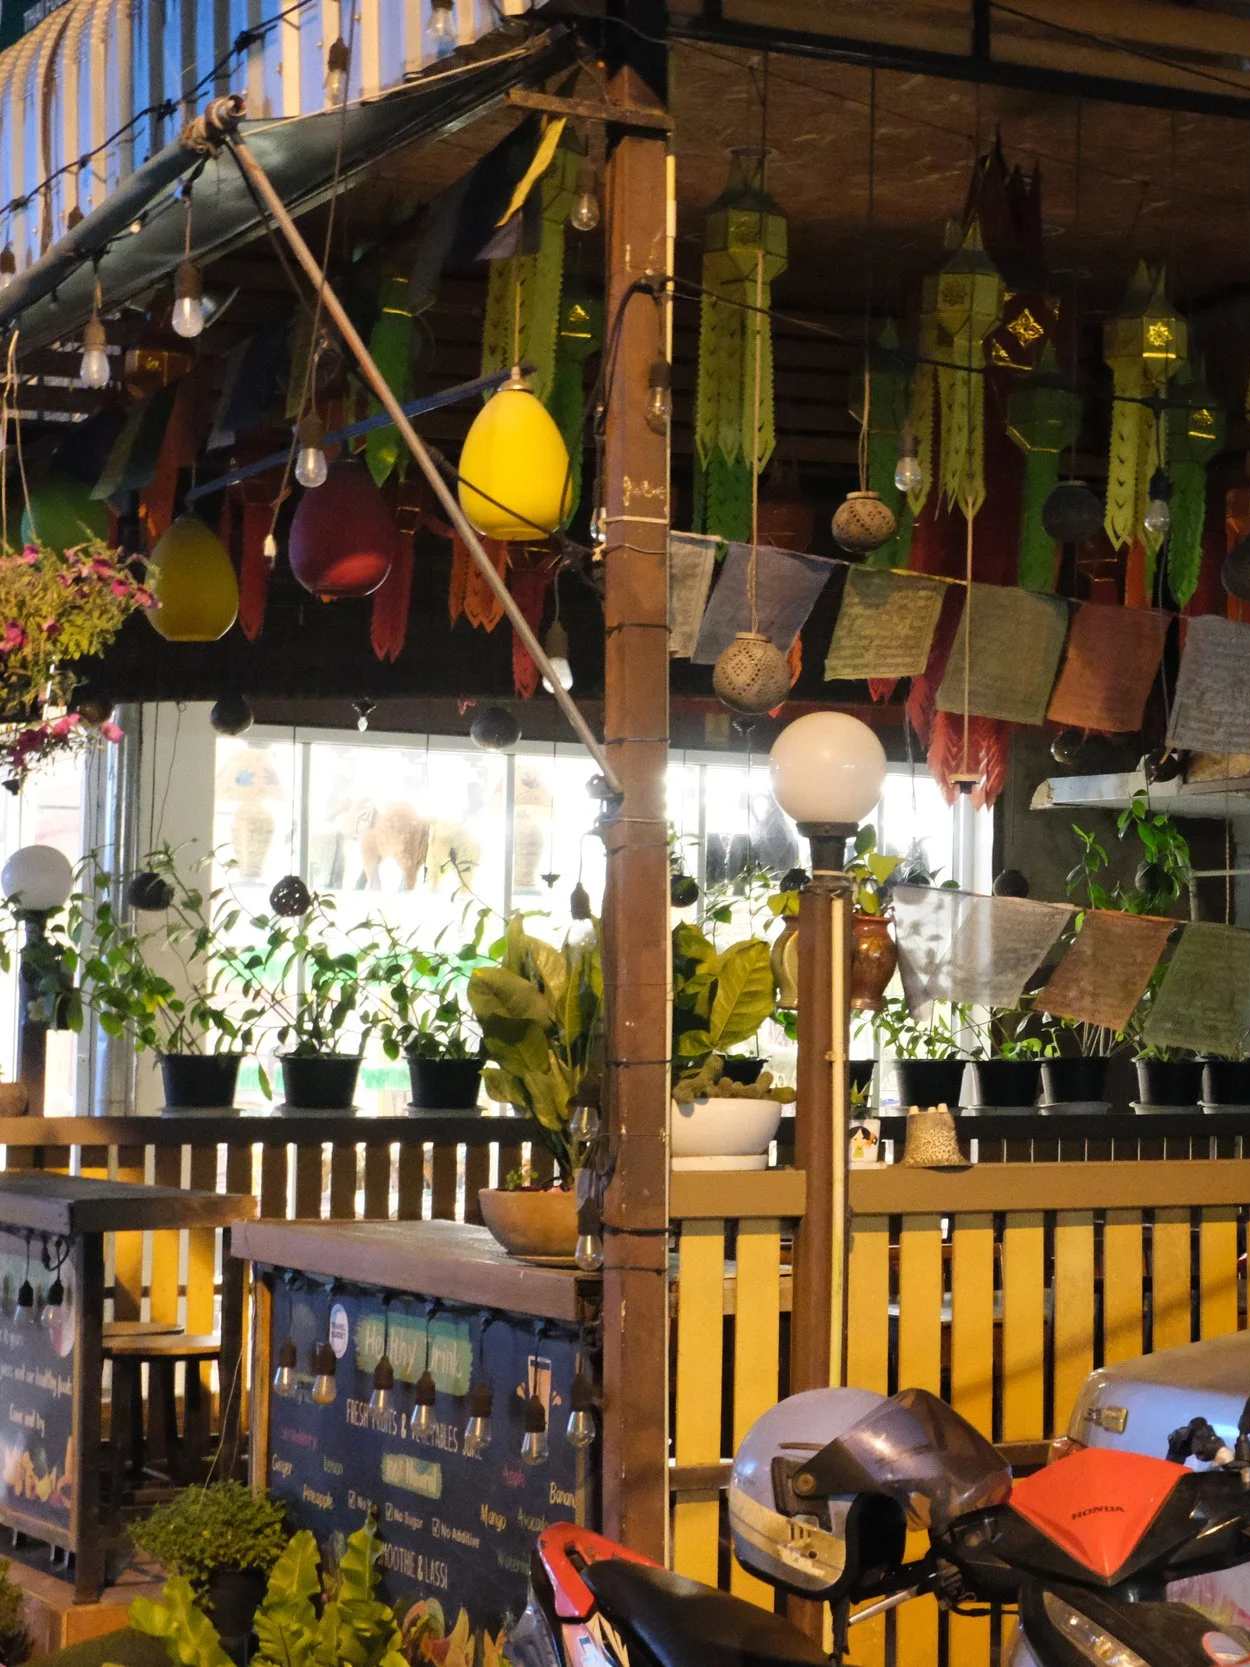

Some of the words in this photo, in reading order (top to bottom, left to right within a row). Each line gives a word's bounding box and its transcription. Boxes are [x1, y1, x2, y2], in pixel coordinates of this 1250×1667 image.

[480, 1503, 507, 1533] Mango
[1072, 1505, 1126, 1521] HONDA
[424, 1557, 448, 1590] LASSI
